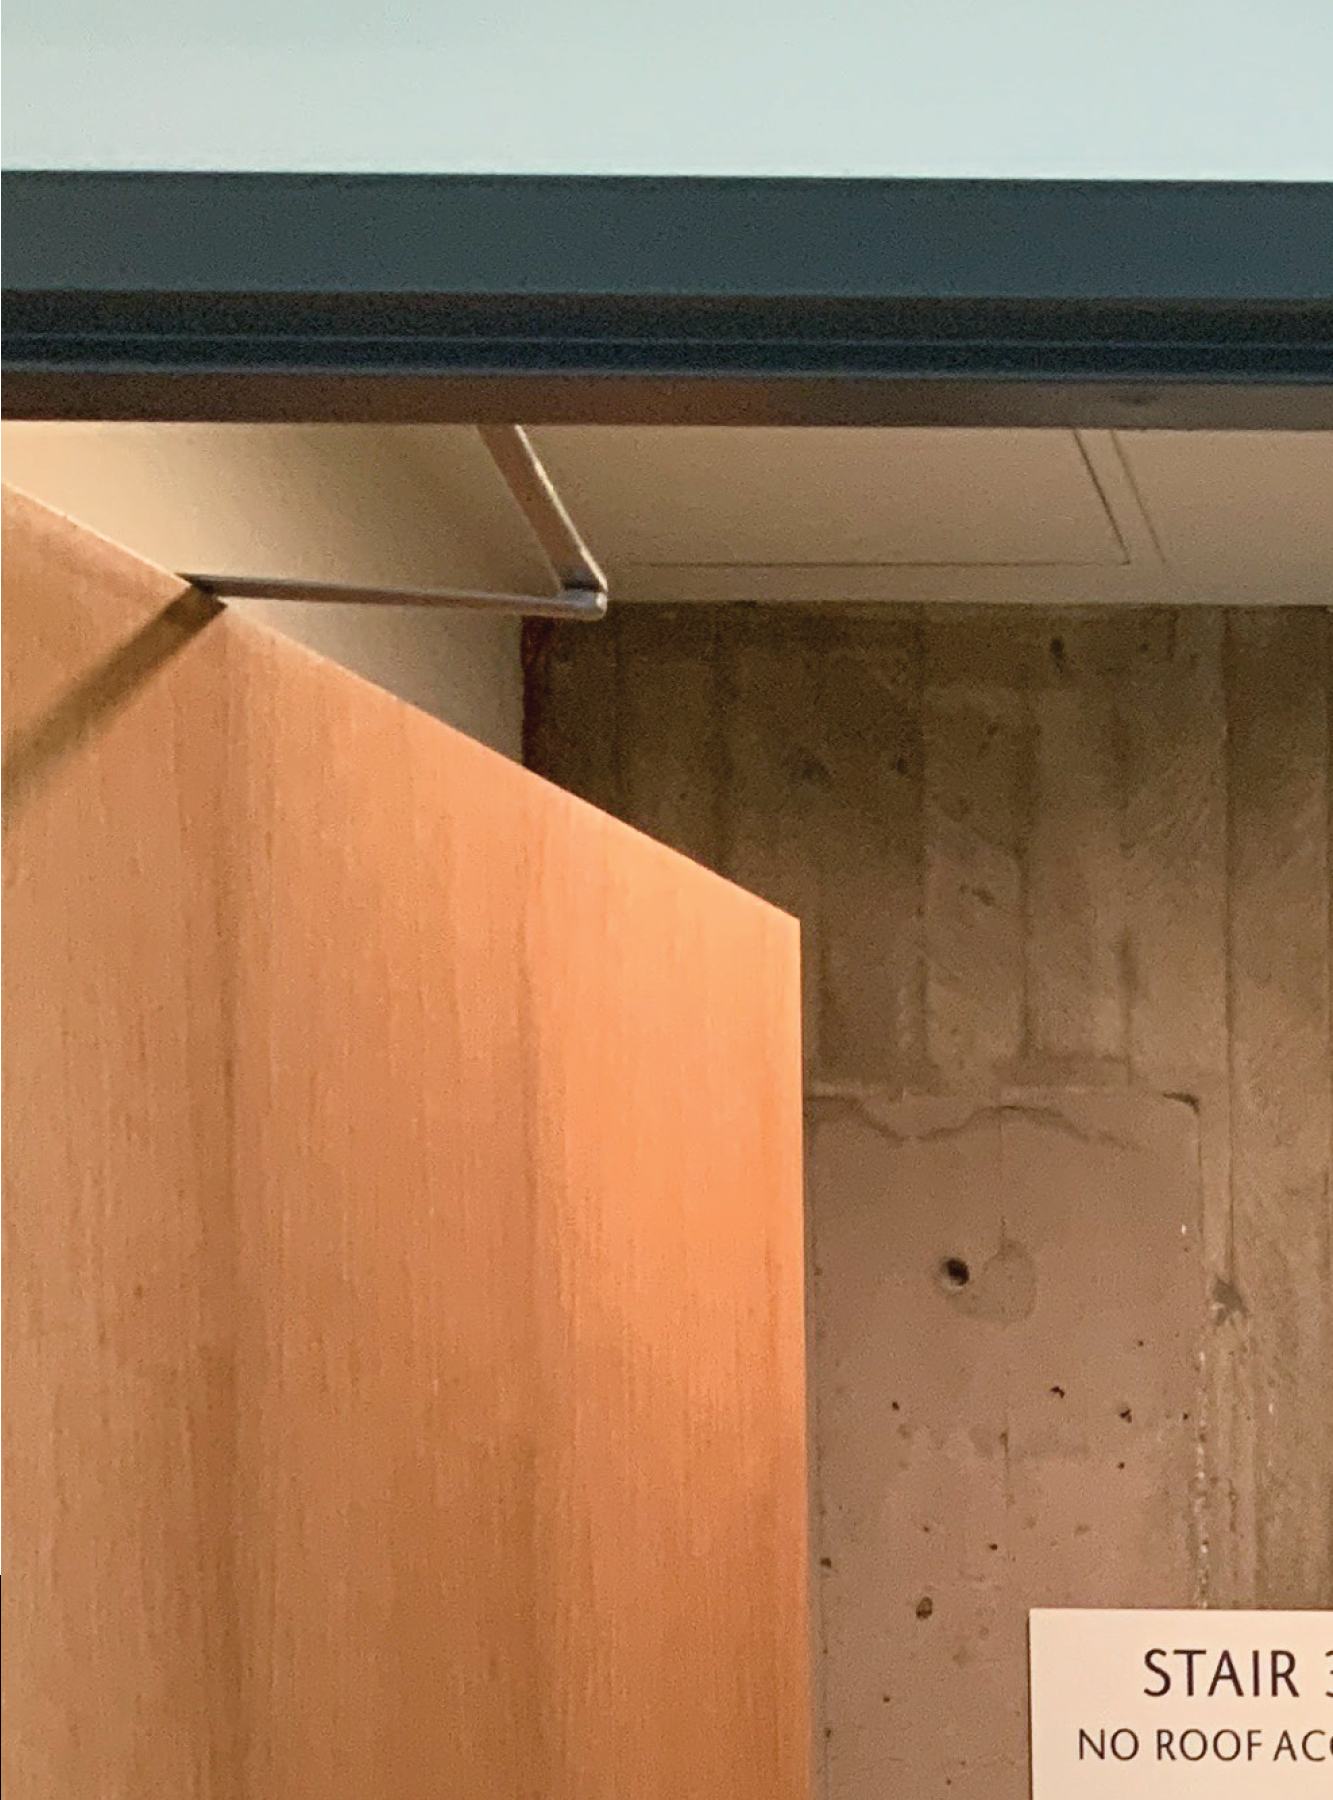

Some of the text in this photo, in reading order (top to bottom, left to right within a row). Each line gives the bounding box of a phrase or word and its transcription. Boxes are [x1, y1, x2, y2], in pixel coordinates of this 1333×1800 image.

[1143, 1647, 1300, 1698] STAIR
[1078, 1727, 1140, 1762] NO
[1156, 1728, 1263, 1762] ROOF
